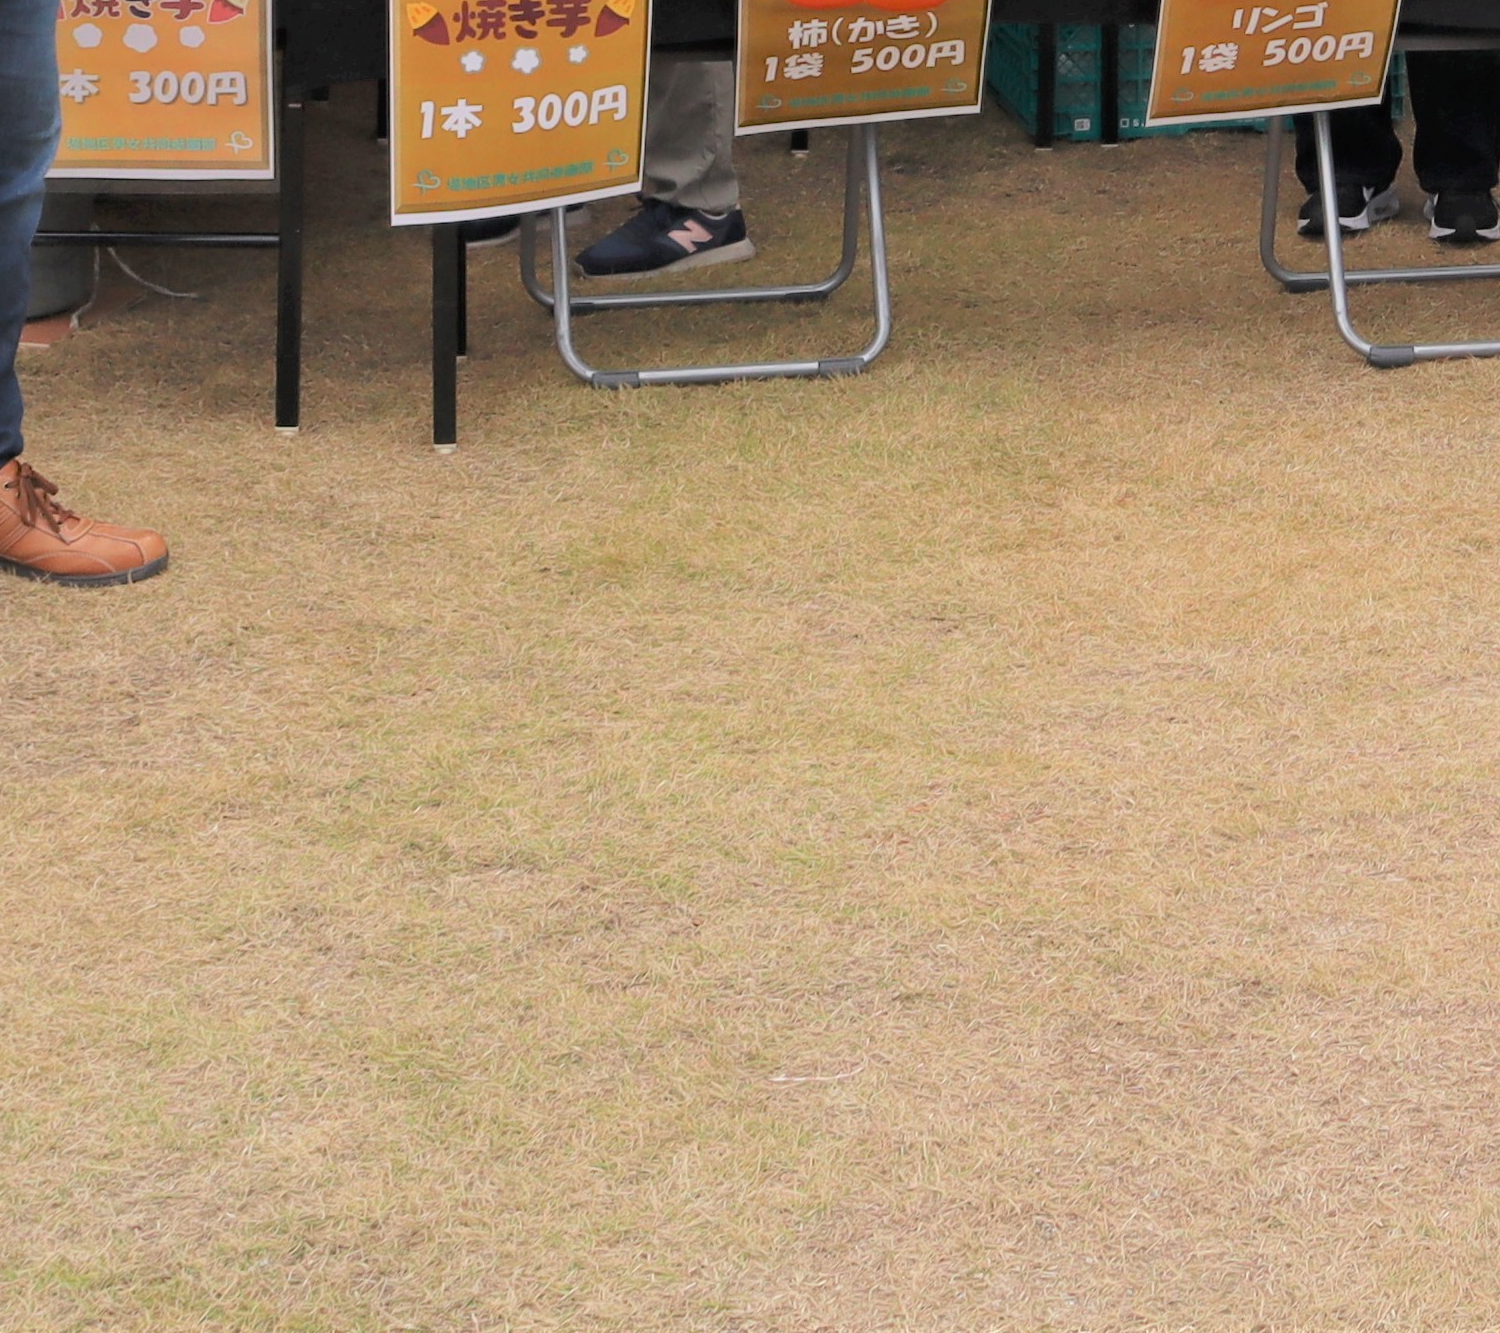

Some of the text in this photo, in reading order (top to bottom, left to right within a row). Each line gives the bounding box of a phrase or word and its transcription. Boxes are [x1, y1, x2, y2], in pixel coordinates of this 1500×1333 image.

[1232, 1, 1329, 35] リンゴ
[764, 39, 966, 82] 1袋 500円
[1180, 31, 1375, 75] 1袋 500円
[61, 68, 248, 106] 本 300円
[420, 84, 629, 139] 1本 300円
